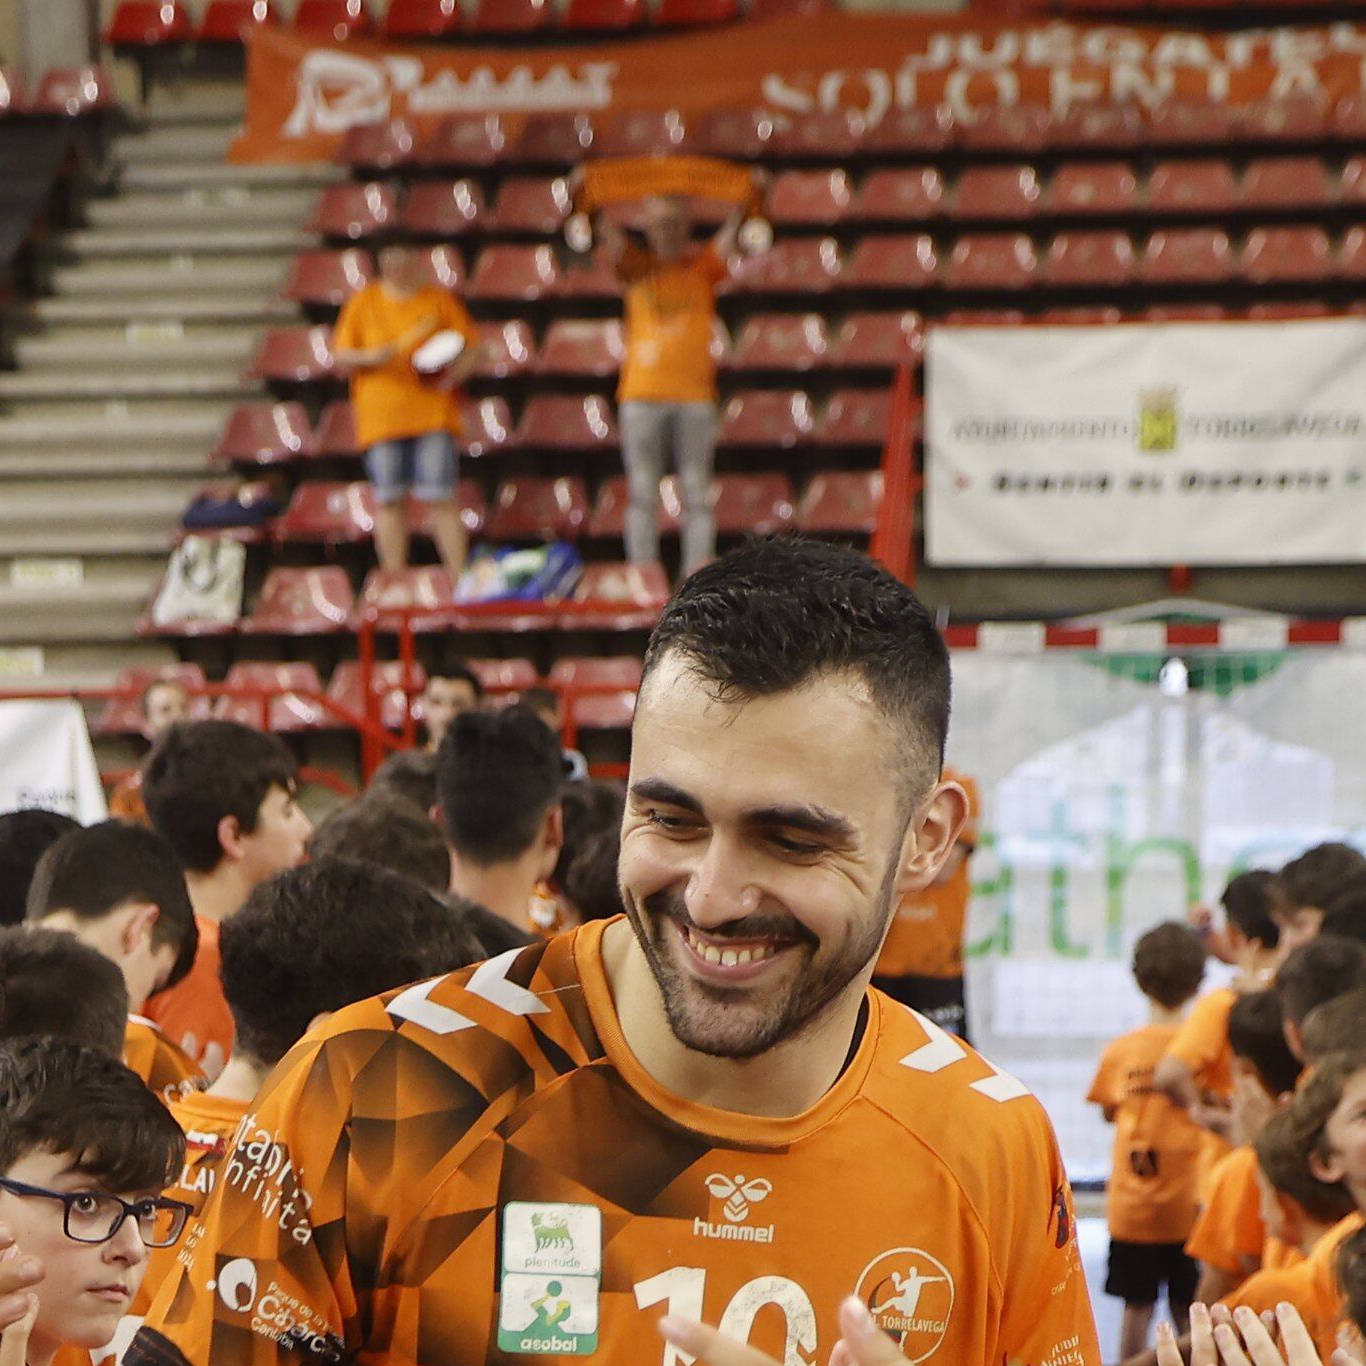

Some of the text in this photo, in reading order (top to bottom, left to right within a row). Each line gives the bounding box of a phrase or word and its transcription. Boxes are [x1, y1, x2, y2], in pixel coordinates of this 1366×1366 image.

[693, 1217, 775, 1243] hummel
[524, 1255, 581, 1269] plenitude
[881, 1314, 947, 1334] TORRELAVEGA
[519, 1334, 578, 1353] asobal
